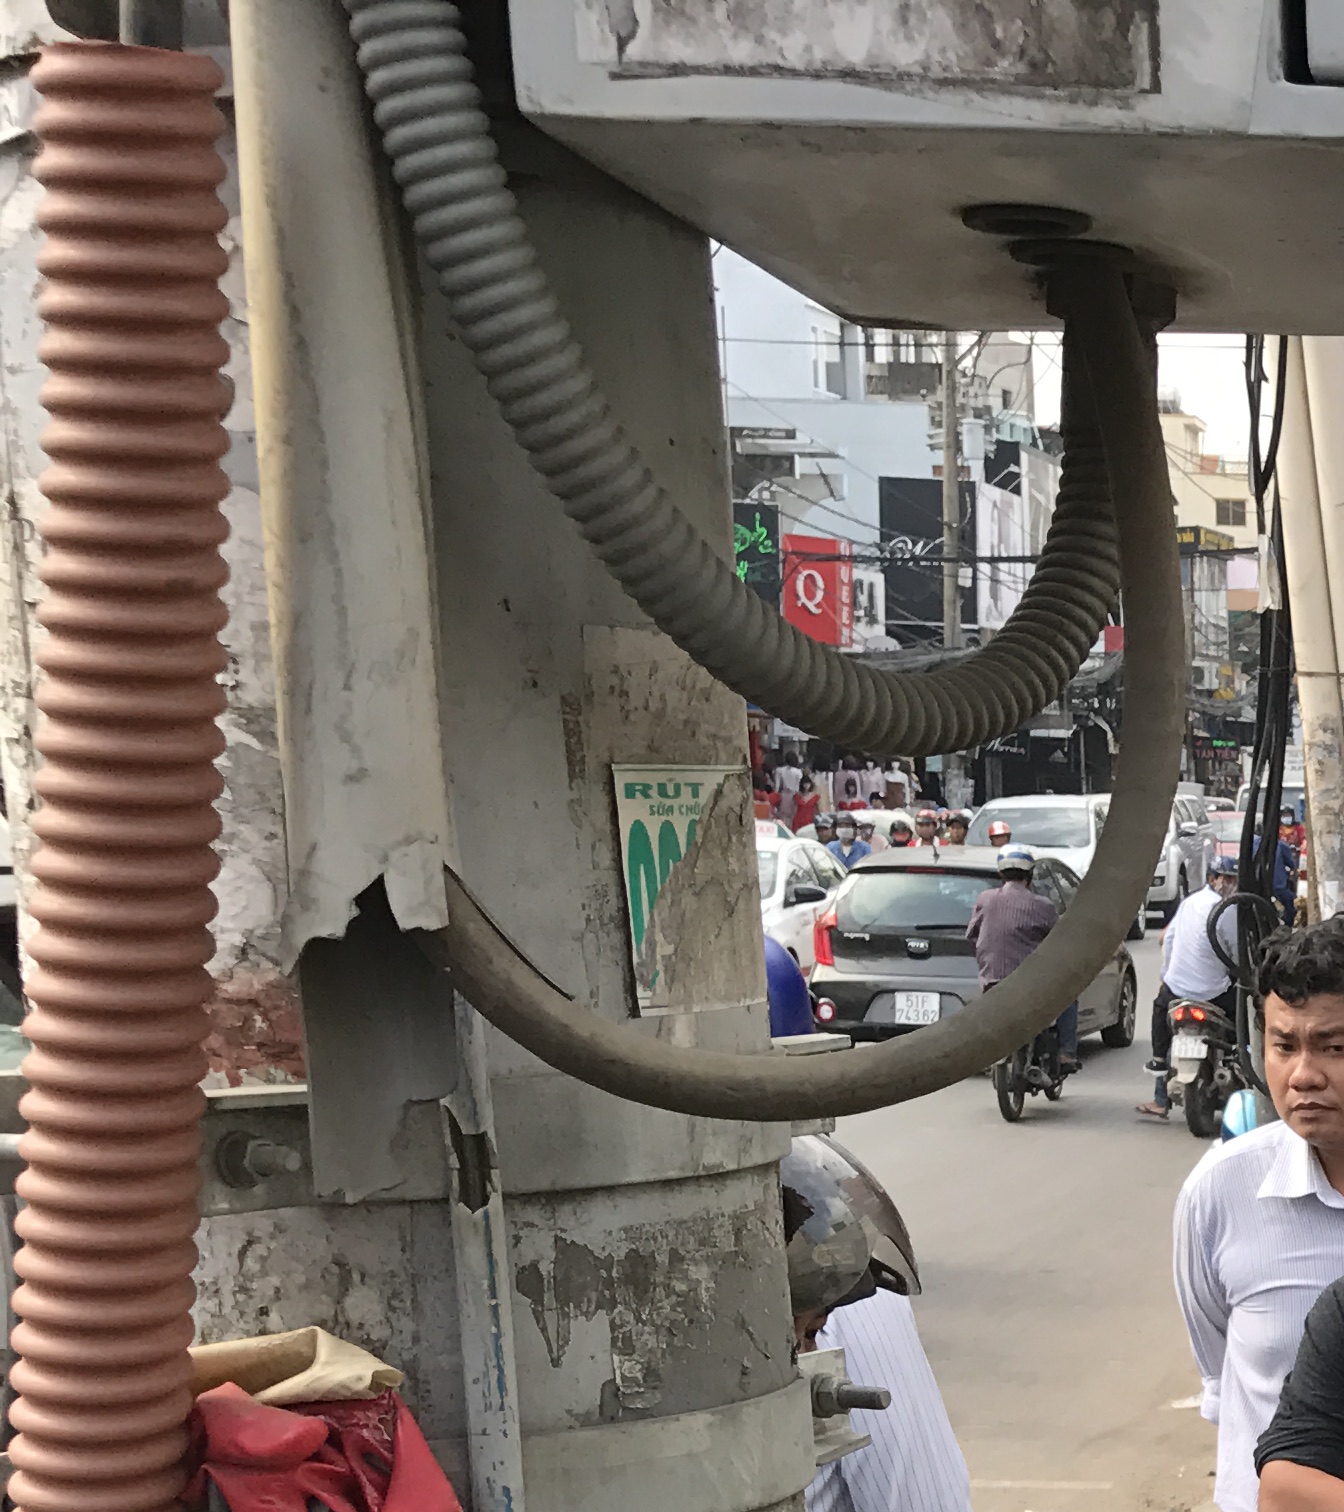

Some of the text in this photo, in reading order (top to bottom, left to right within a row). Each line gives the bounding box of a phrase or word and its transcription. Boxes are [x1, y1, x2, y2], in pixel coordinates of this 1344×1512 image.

[796, 569, 825, 614] Q
[624, 777, 704, 799] RÚT
[905, 995, 929, 1008] 51F
